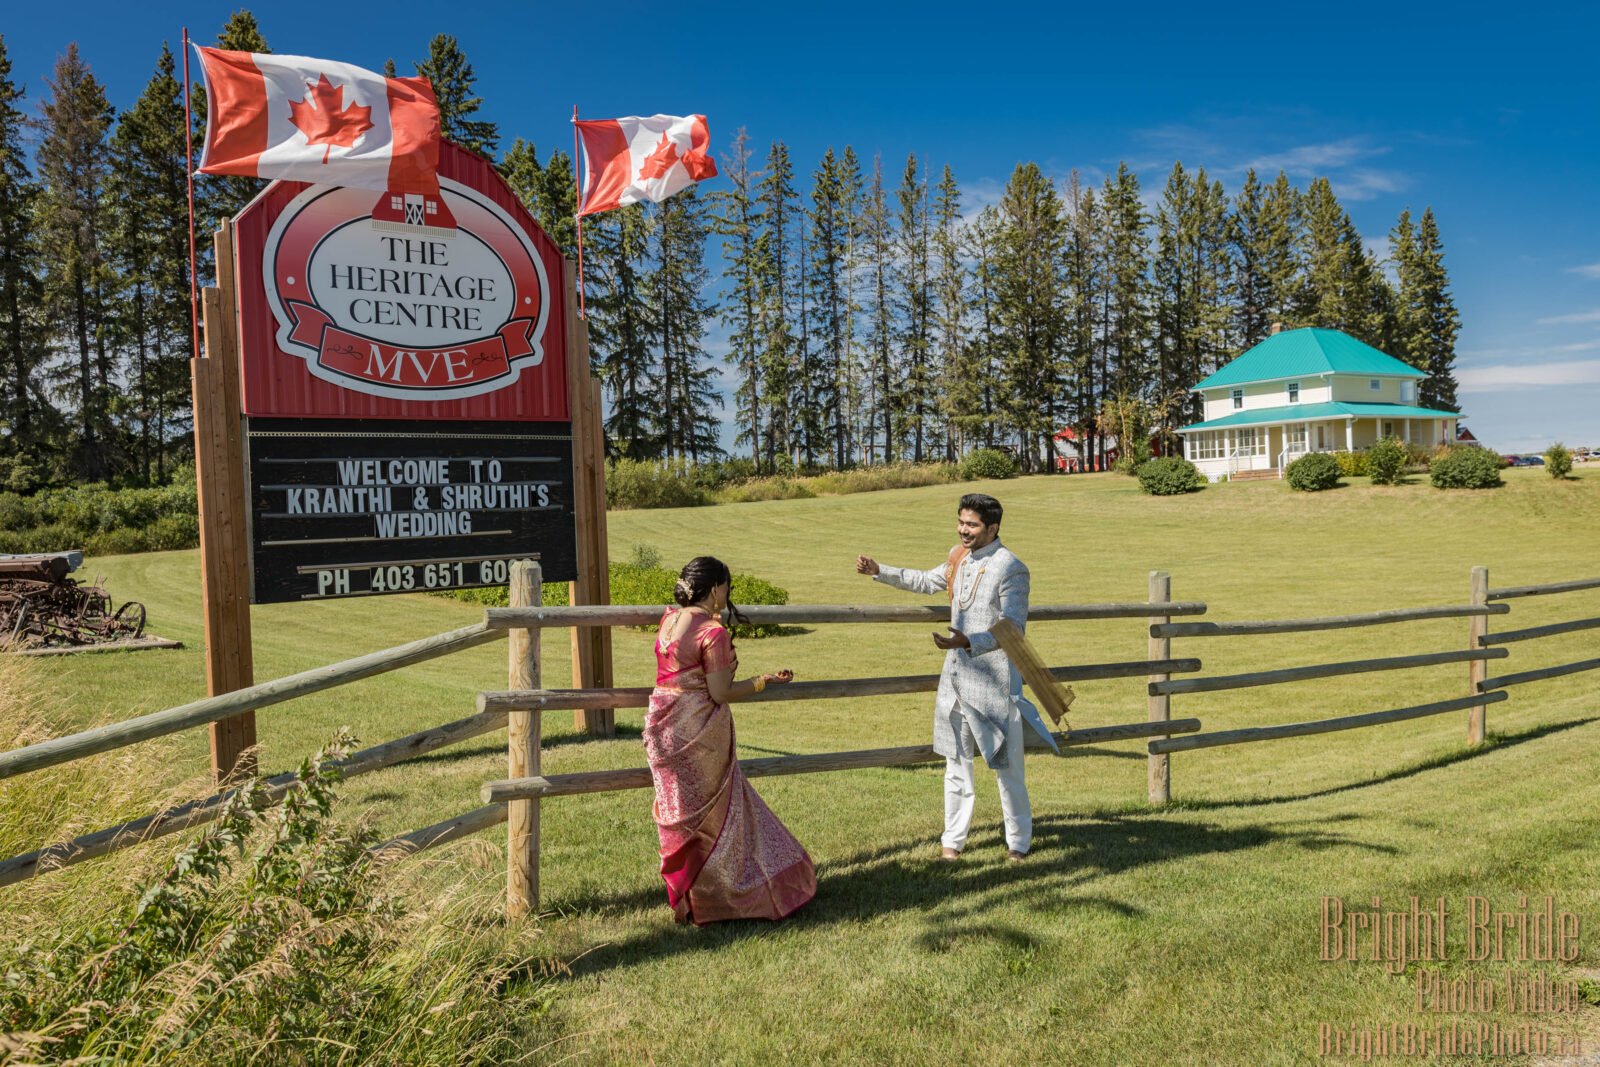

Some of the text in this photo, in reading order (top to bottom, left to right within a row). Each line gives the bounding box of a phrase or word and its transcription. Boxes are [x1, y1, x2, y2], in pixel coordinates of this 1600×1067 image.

[381, 237, 449, 266] THE
[330, 264, 497, 302] HERITAGE
[349, 298, 482, 331] CENTRE
[363, 344, 474, 383] MVE
[338, 460, 502, 486] WELCOME TO
[287, 484, 549, 514] KRANTHI & SHRUTHI'S
[375, 511, 472, 538] WEDDING
[319, 569, 350, 596] PH
[372, 566, 415, 592] 403
[424, 562, 464, 588] 651
